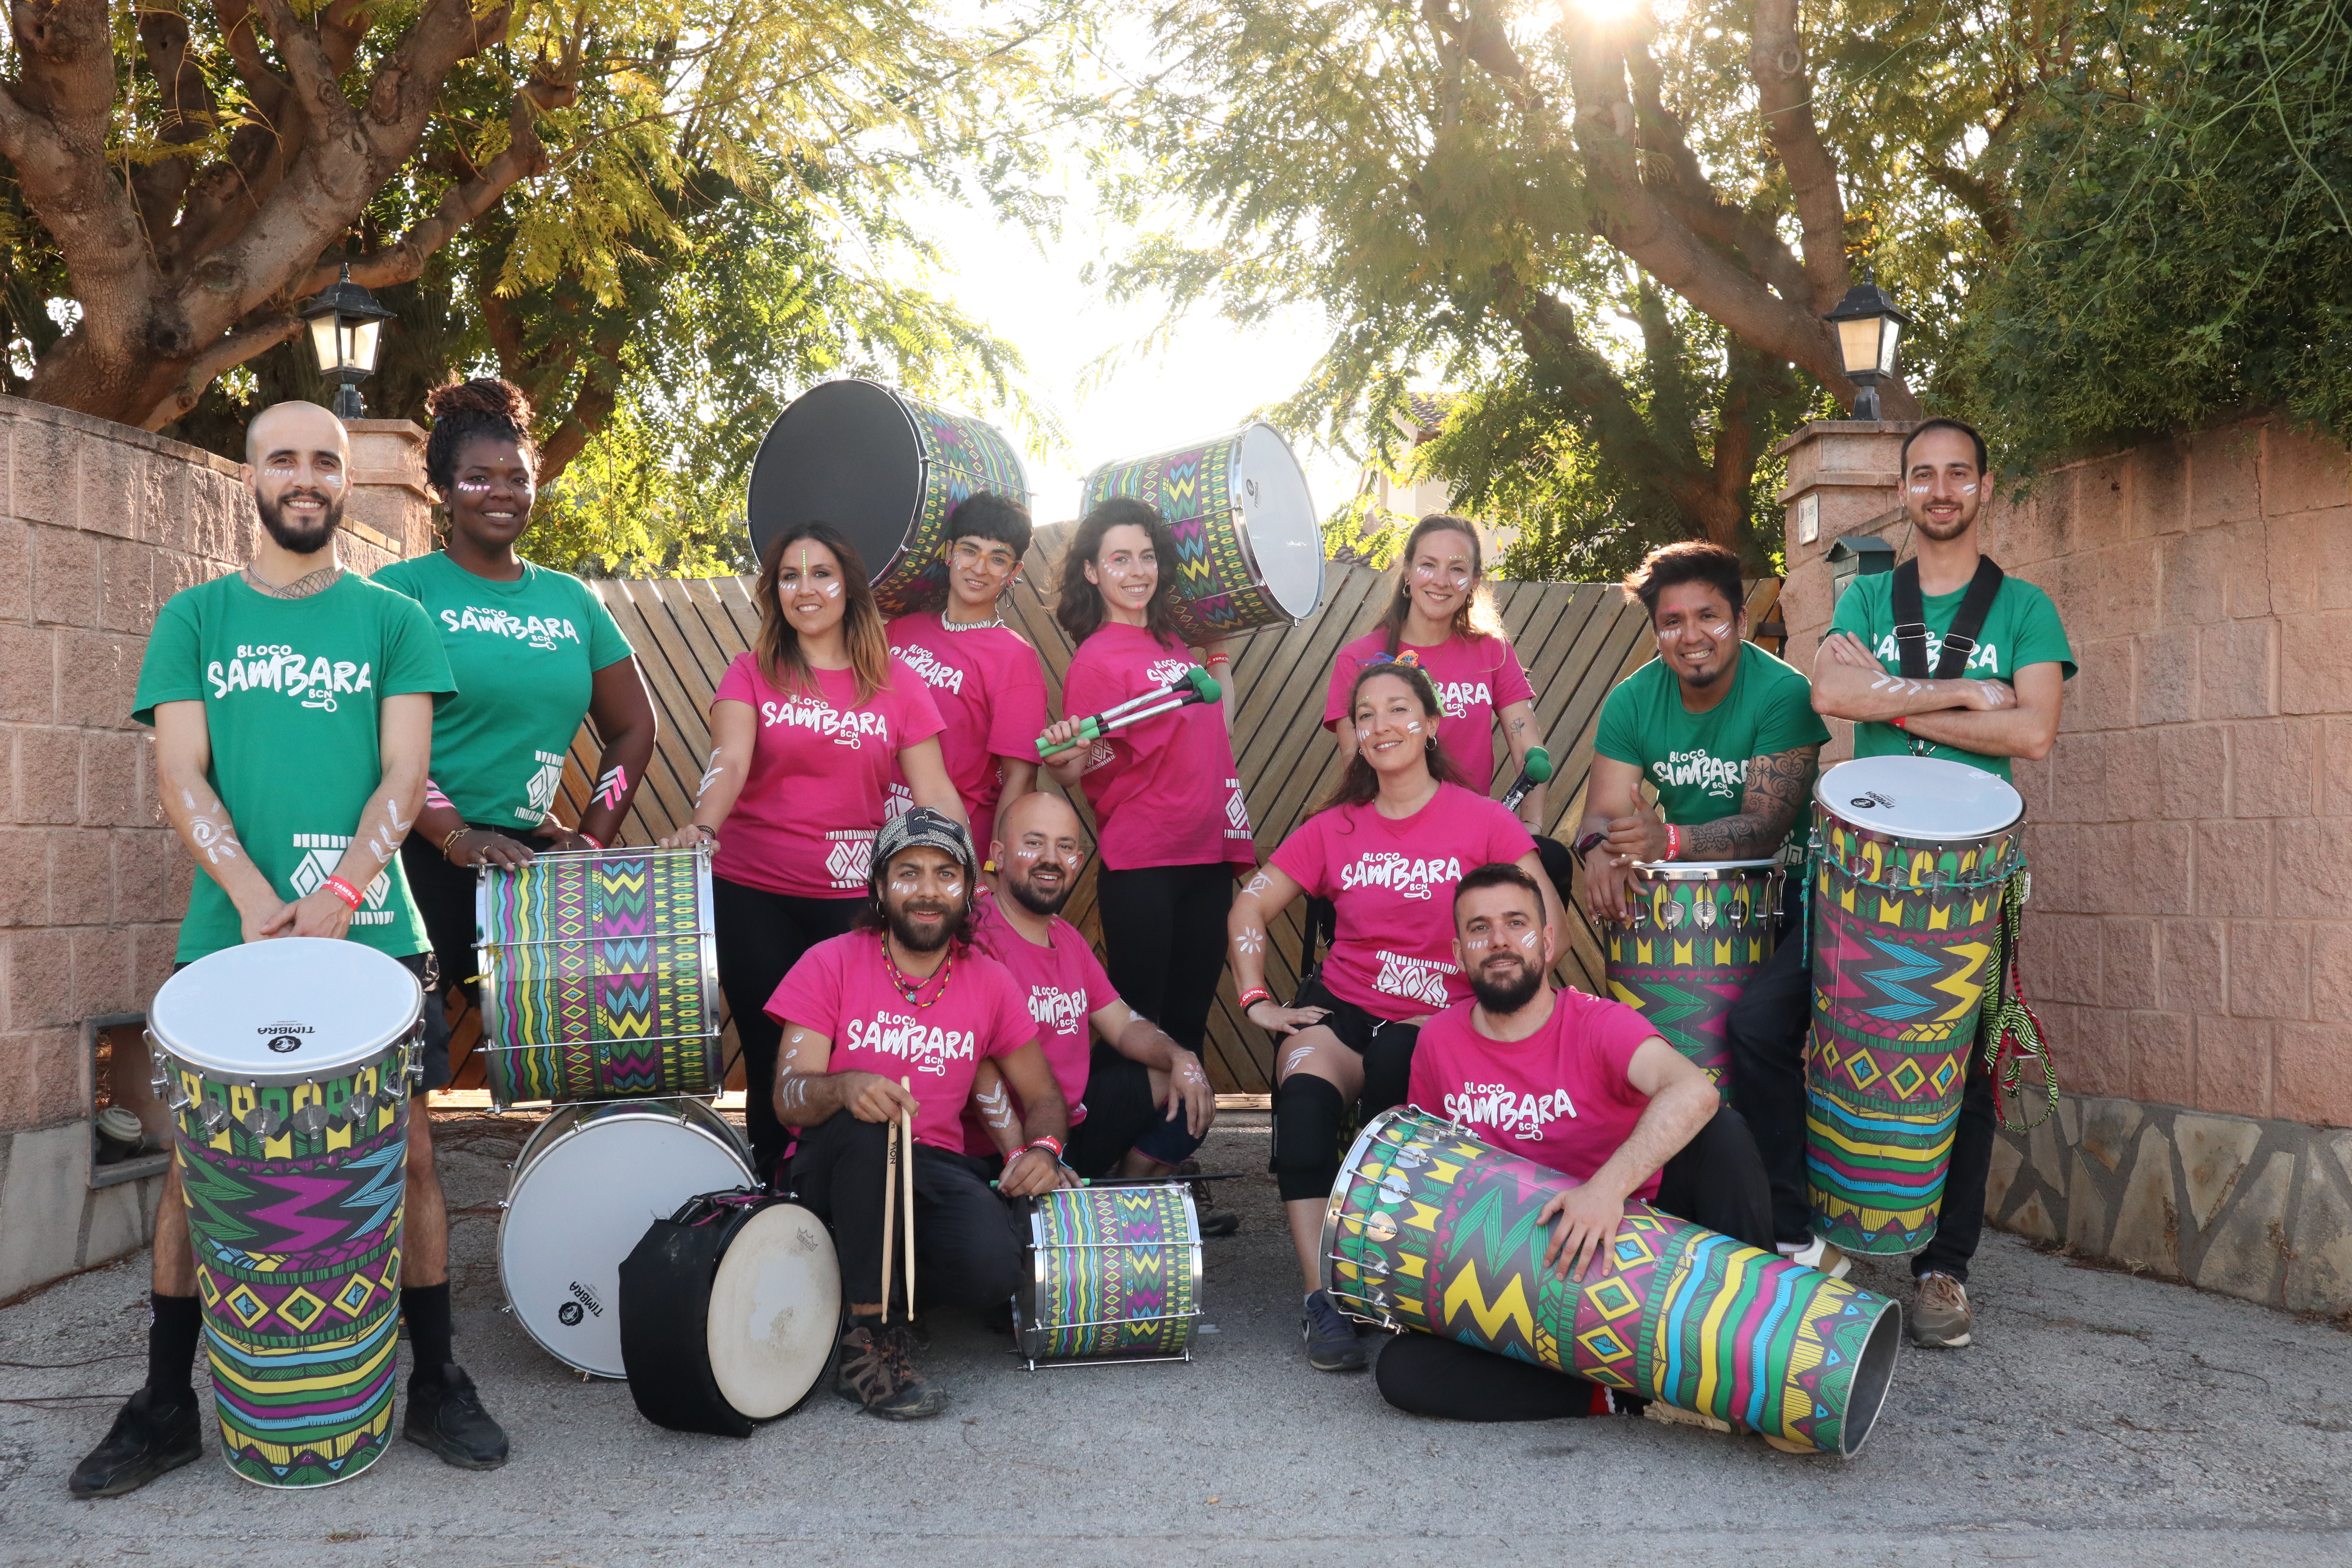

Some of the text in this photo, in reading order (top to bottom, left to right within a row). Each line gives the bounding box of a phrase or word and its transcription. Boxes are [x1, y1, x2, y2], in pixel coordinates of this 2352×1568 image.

[466, 606, 507, 618] BLOCO
[440, 610, 580, 644] SAMBARA
[237, 645, 292, 658] BLOCO
[908, 644, 933, 658] BLOCO
[1154, 659, 1177, 669] BLOCO
[208, 654, 373, 699] SAMBARA
[309, 688, 332, 699] BCN
[790, 695, 829, 709] BLOCO
[762, 701, 887, 742] SAMBARA
[840, 730, 858, 739] BCN
[1670, 748, 1706, 763] BLOCO
[1865, 791, 1895, 809] TIMBRA
[1362, 852, 1400, 862] BLOCO
[1341, 857, 1463, 891] SAMBARA
[1032, 985, 1058, 996] BLOCO
[1242, 990, 1264, 1001] CULTURA
[877, 1011, 916, 1027] BLOCO
[1060, 1018, 1076, 1027] BCN
[258, 1026, 315, 1034] TIMBRA
[847, 1019, 975, 1063] SAMBARA
[924, 1055, 944, 1065] BCN
[1464, 1082, 1505, 1094] BLOCO
[1444, 1089, 1577, 1131] SAMBARA
[1518, 1122, 1539, 1131] BCN
[889, 1140, 897, 1164] NOVA
[799, 1234, 813, 1250] REMO
[569, 1281, 603, 1318] TIMBRA
